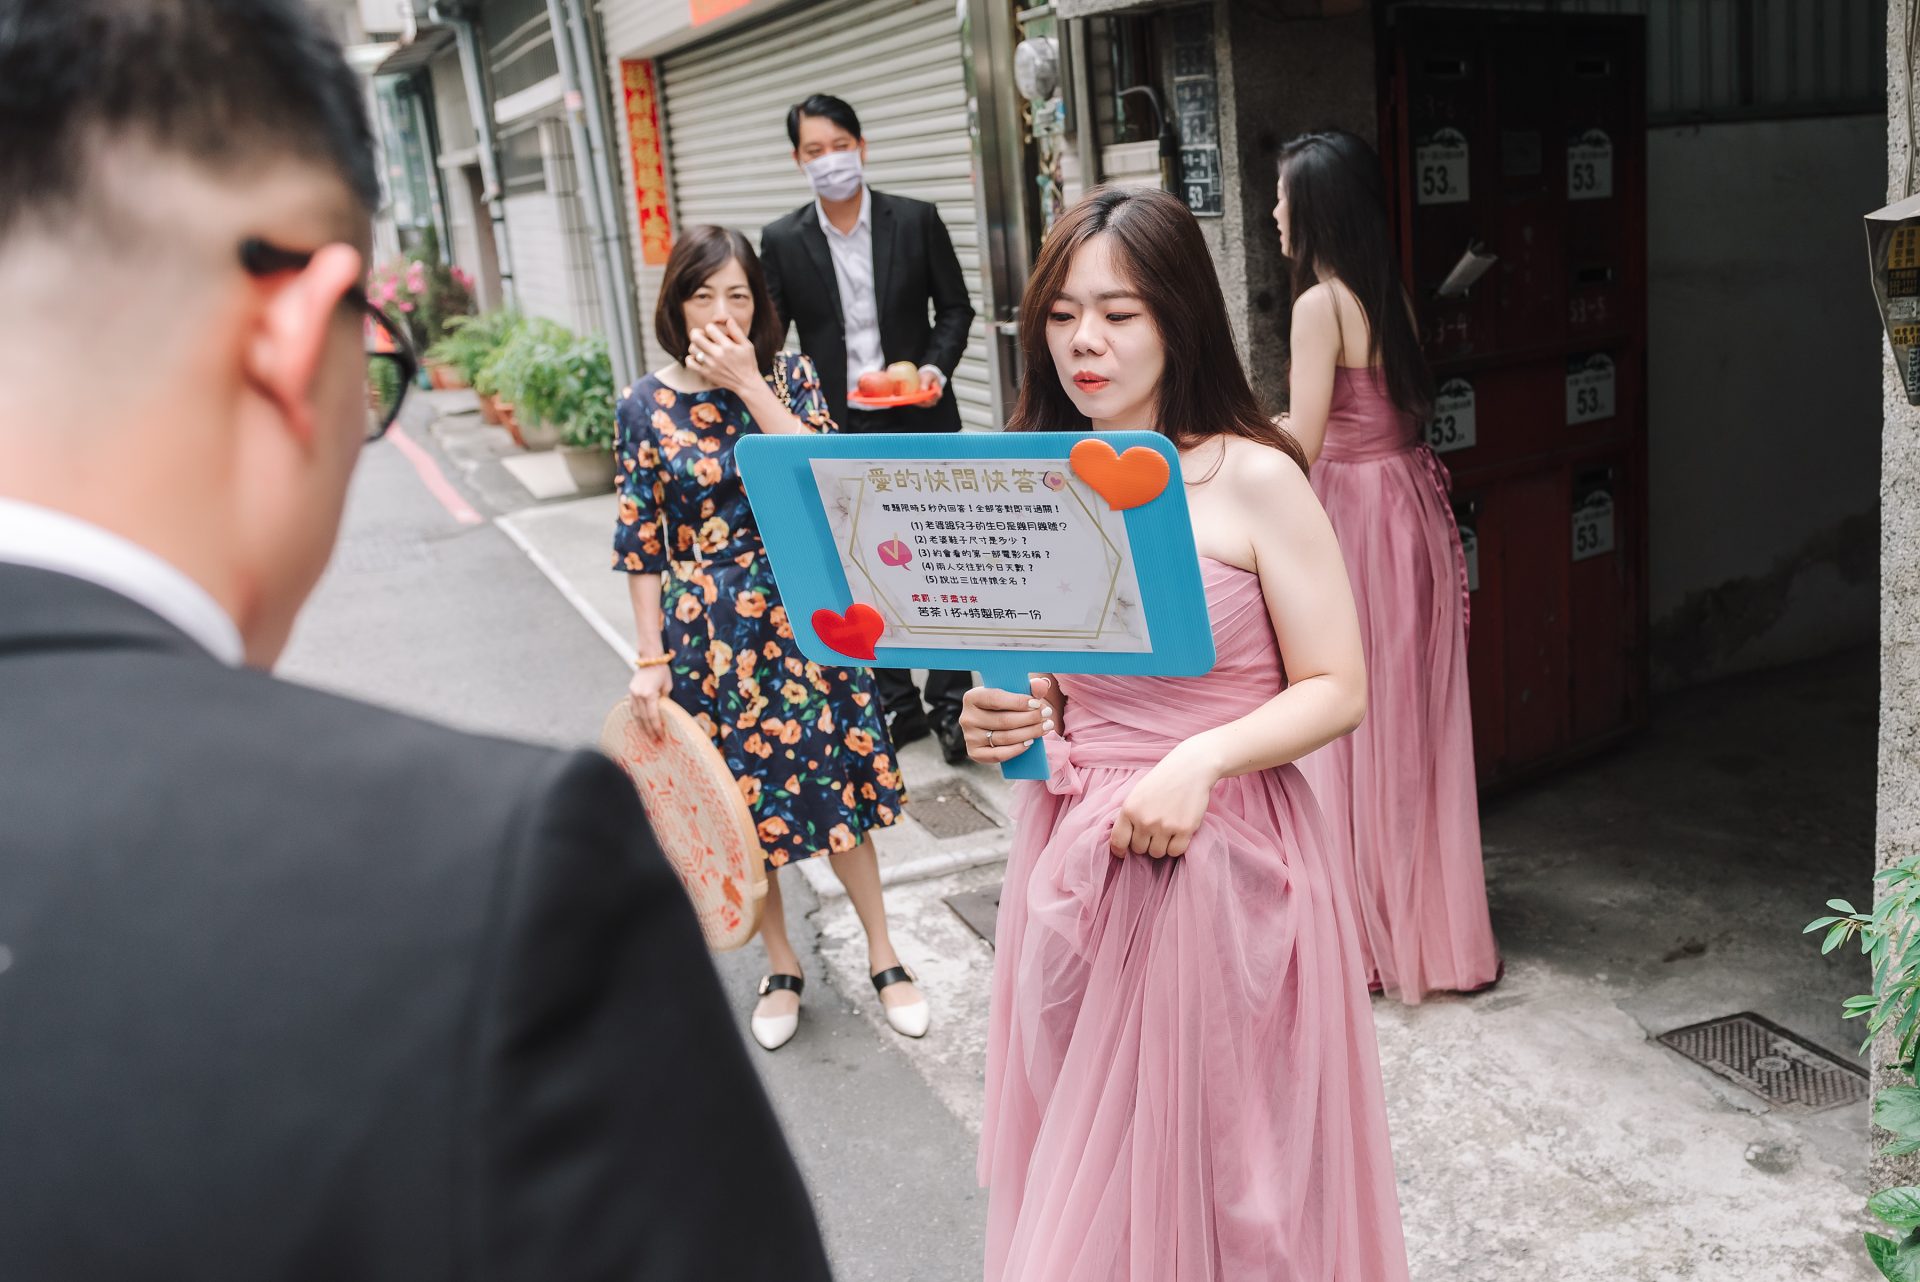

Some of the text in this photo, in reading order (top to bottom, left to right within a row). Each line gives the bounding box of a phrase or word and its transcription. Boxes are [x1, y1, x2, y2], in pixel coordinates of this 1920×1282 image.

[1423, 165, 1449, 196] 53
[1573, 163, 1596, 191] 53
[1188, 185, 1204, 209] 53
[1577, 387, 1599, 415] 53
[1431, 415, 1457, 446] 53
[867, 467, 1038, 494] 愛的快問快答
[1577, 523, 1599, 552] 53
